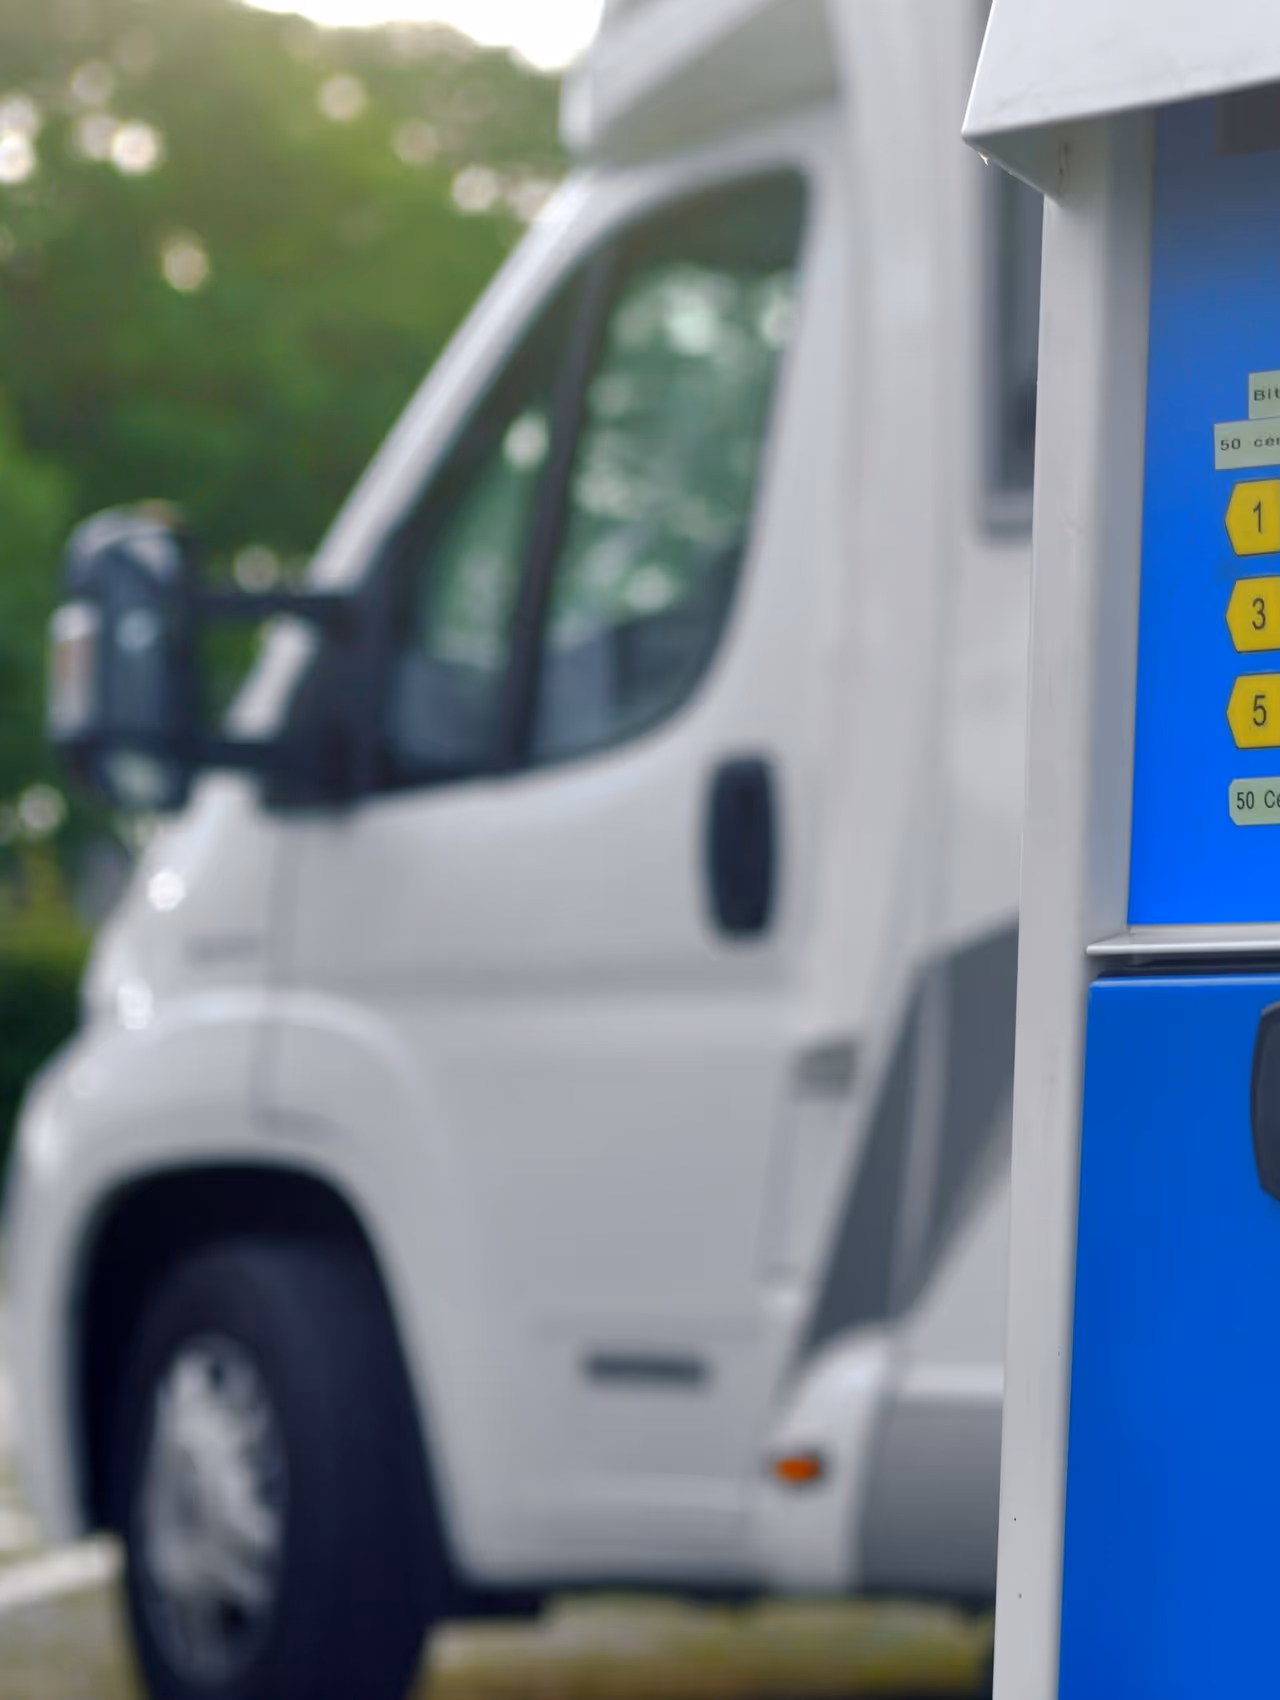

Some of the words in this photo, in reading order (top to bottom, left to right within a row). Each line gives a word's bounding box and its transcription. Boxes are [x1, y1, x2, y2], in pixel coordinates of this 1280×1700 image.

[1219, 438, 1242, 452] 50
[1252, 500, 1263, 533] 1
[1251, 597, 1267, 631] 3
[1252, 694, 1267, 727] 5
[1236, 791, 1255, 810] 50
